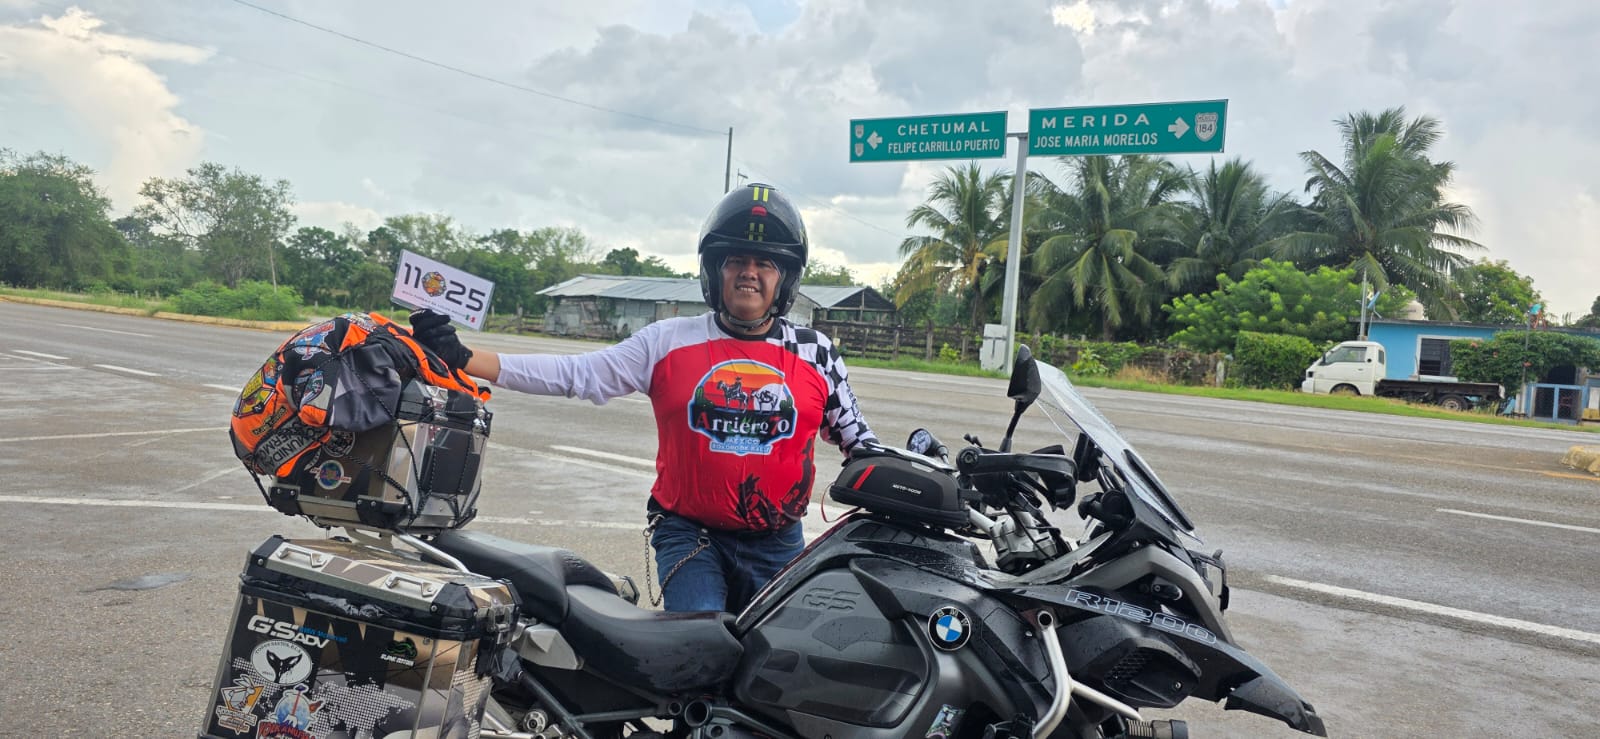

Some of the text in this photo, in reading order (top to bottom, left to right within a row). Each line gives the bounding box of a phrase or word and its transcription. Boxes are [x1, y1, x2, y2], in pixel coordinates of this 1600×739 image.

[897, 121, 990, 136] CHETUMAL
[1041, 113, 1150, 129] MERIDA
[1199, 123, 1213, 133] 184
[888, 138, 1000, 154] FELIPE CARRILLO PUERTO
[1034, 132, 1158, 148] JOSE MARIA MORELOS
[936, 608, 970, 627] BMW
[1065, 589, 1217, 644] R1200
